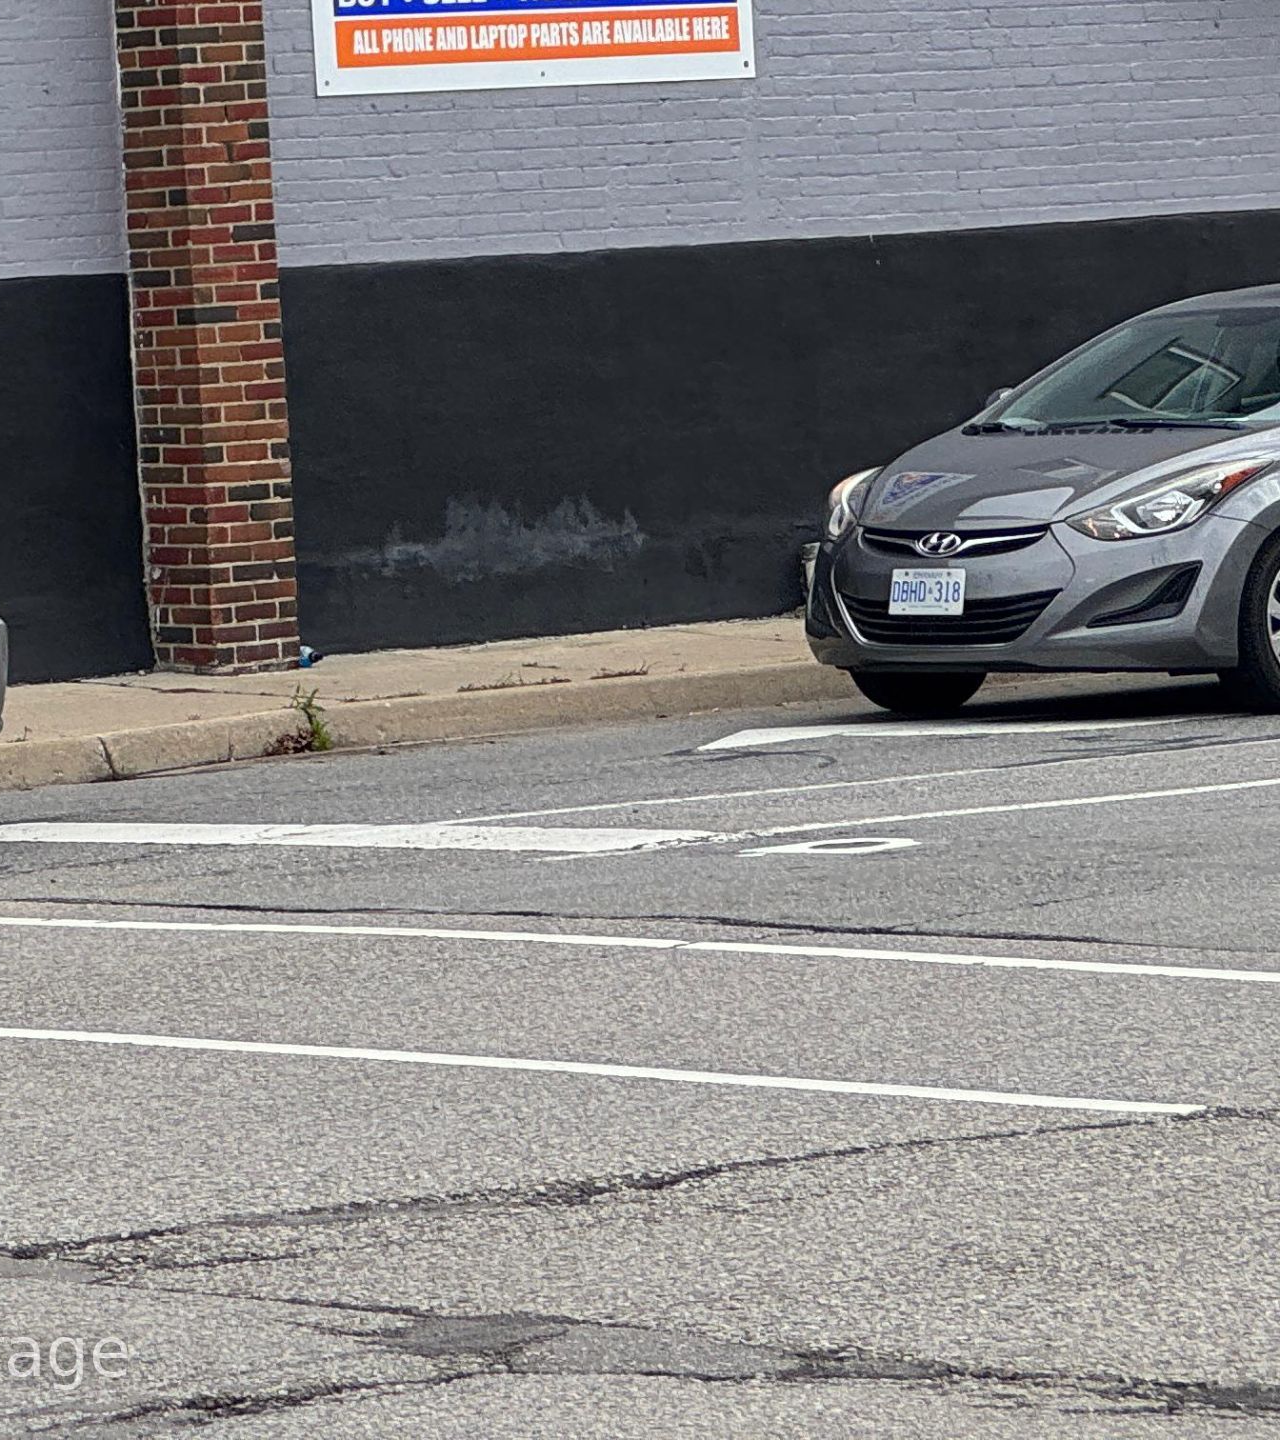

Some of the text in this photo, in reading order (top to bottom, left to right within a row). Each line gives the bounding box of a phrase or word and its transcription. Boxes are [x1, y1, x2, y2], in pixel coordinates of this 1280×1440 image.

[353, 15, 730, 55] ALL PHONE AND LAPTOP PARTS ARE AVAILABLE HERE
